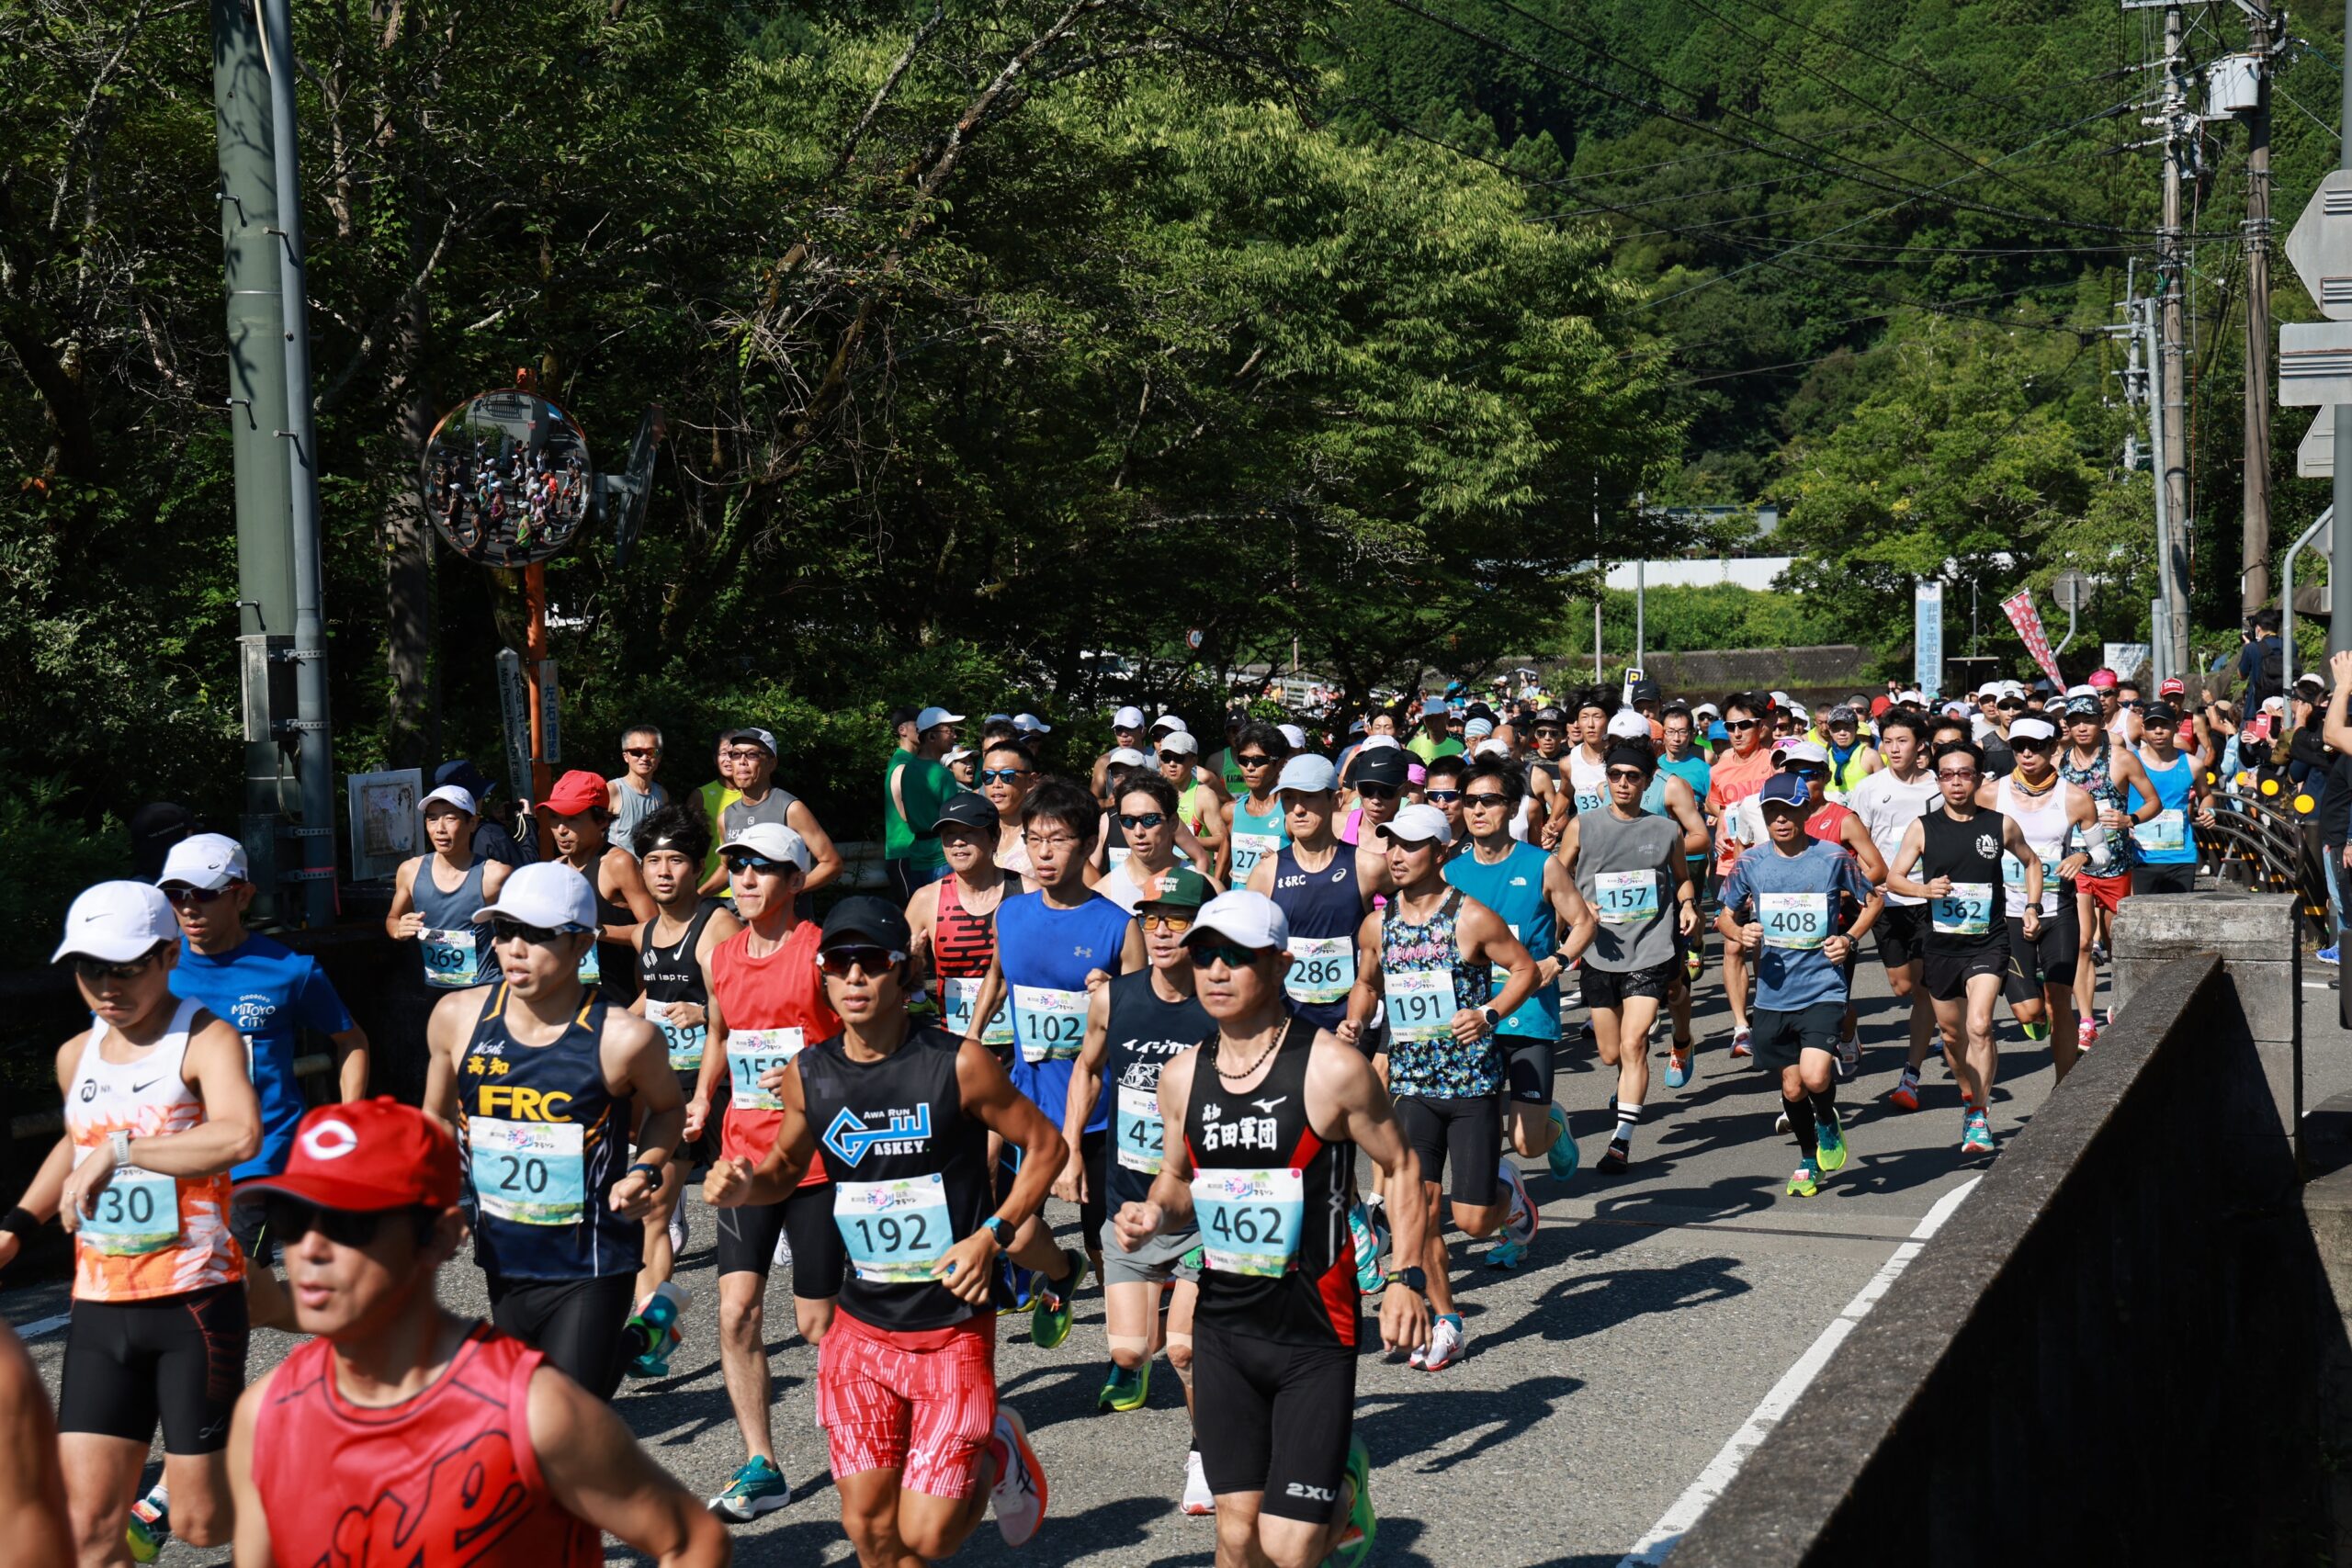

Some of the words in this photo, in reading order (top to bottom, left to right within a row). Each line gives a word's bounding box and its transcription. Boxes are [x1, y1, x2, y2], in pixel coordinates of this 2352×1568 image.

[500, 668, 508, 686] May
[1630, 672, 1640, 685] P
[503, 688, 511, 716] Peace
[506, 716, 514, 745] Prevail
[511, 761, 521, 785] Earth
[1580, 795, 1600, 809] 33
[1237, 851, 1261, 868] 27
[2012, 863, 2052, 878] 19
[1607, 887, 1647, 908] 157
[1941, 900, 1982, 919] 562
[1771, 912, 1816, 932] 408
[426, 946, 465, 968] 269
[1294, 958, 1341, 985] 286
[232, 1003, 276, 1016] MITOYO
[956, 1001, 1006, 1024] 48
[1395, 995, 1441, 1021] 191
[239, 1015, 266, 1027] CITY
[1027, 1014, 1082, 1043] 102
[667, 1026, 696, 1050] 39
[467, 1055, 510, 1076] 高知
[478, 1085, 573, 1122] FRC
[1129, 1120, 1164, 1150] 42
[1202, 1116, 1278, 1152] 石田軍団
[499, 1156, 548, 1194] 20
[88, 1186, 154, 1223] 30
[855, 1213, 932, 1253] 192
[1212, 1206, 1284, 1245] 462
[1285, 1482, 1337, 1502] 2XU
